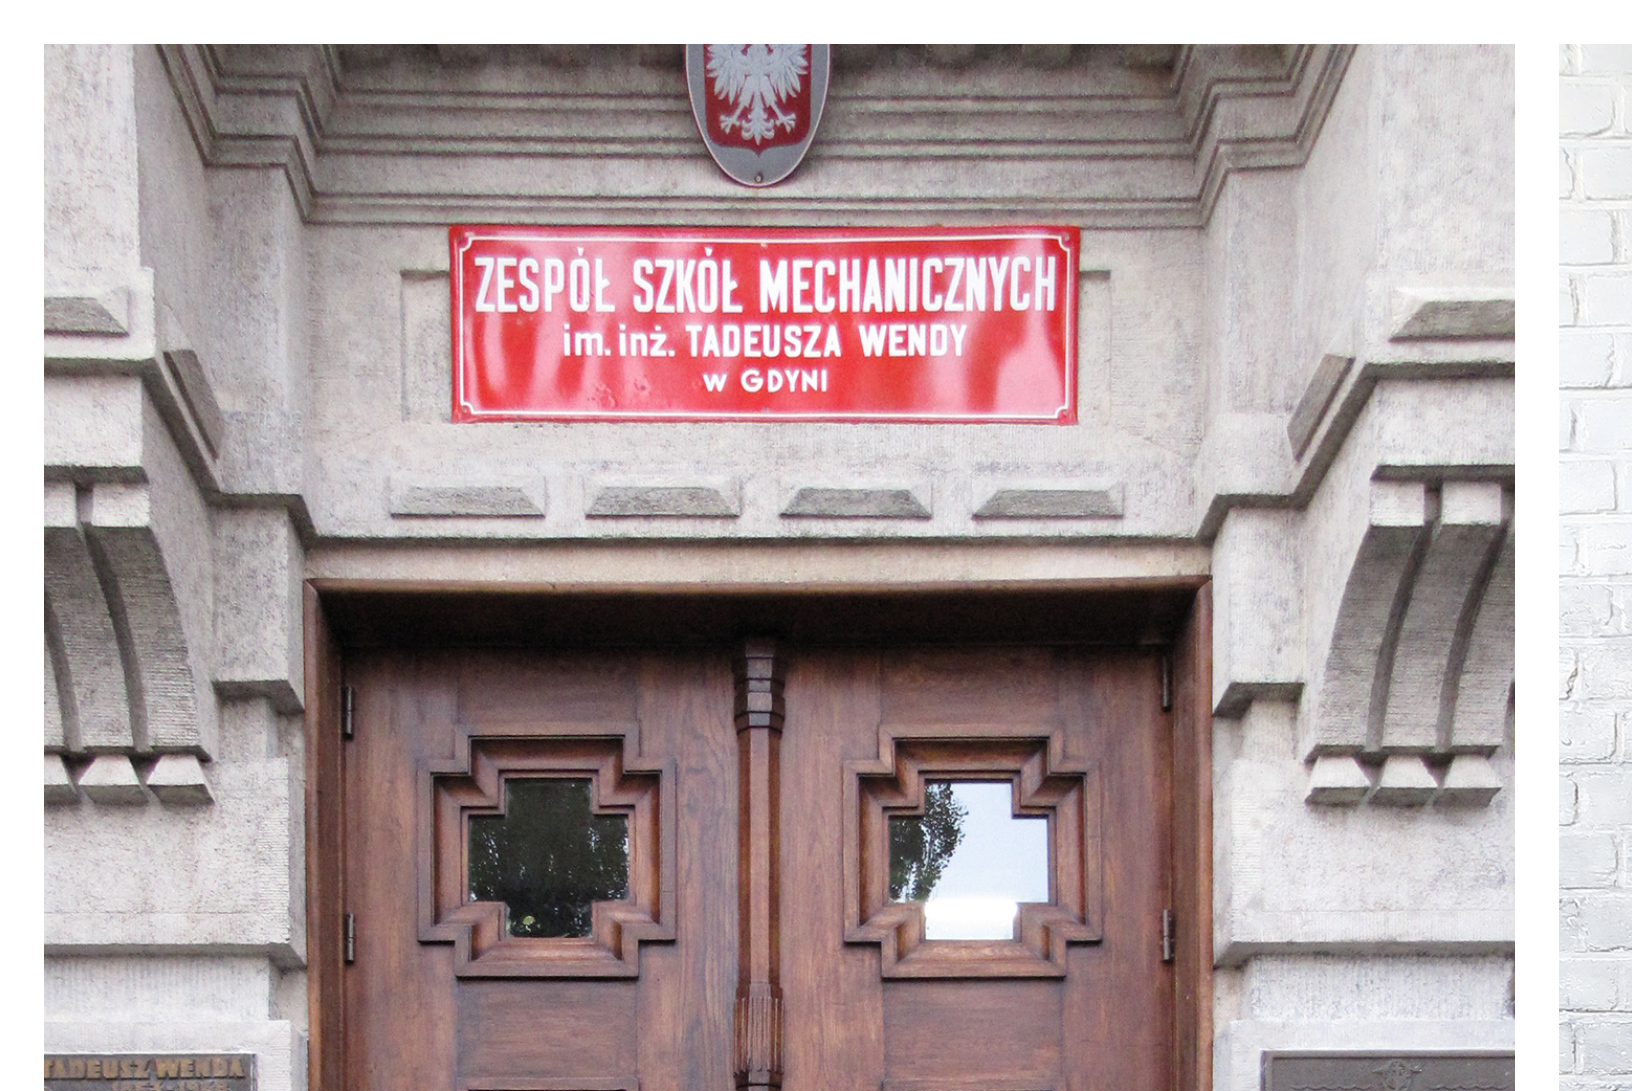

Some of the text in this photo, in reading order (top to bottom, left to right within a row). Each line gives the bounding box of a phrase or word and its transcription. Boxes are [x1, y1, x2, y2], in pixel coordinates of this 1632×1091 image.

[474, 247, 1057, 313] ZESPÓŁ SZKÓŁ MECHANICZNYCH
[562, 323, 968, 358] im. inż. TADEUSZA WENDY
[741, 371, 829, 393] GDYNI
[155, 1058, 245, 1079] WENDA
